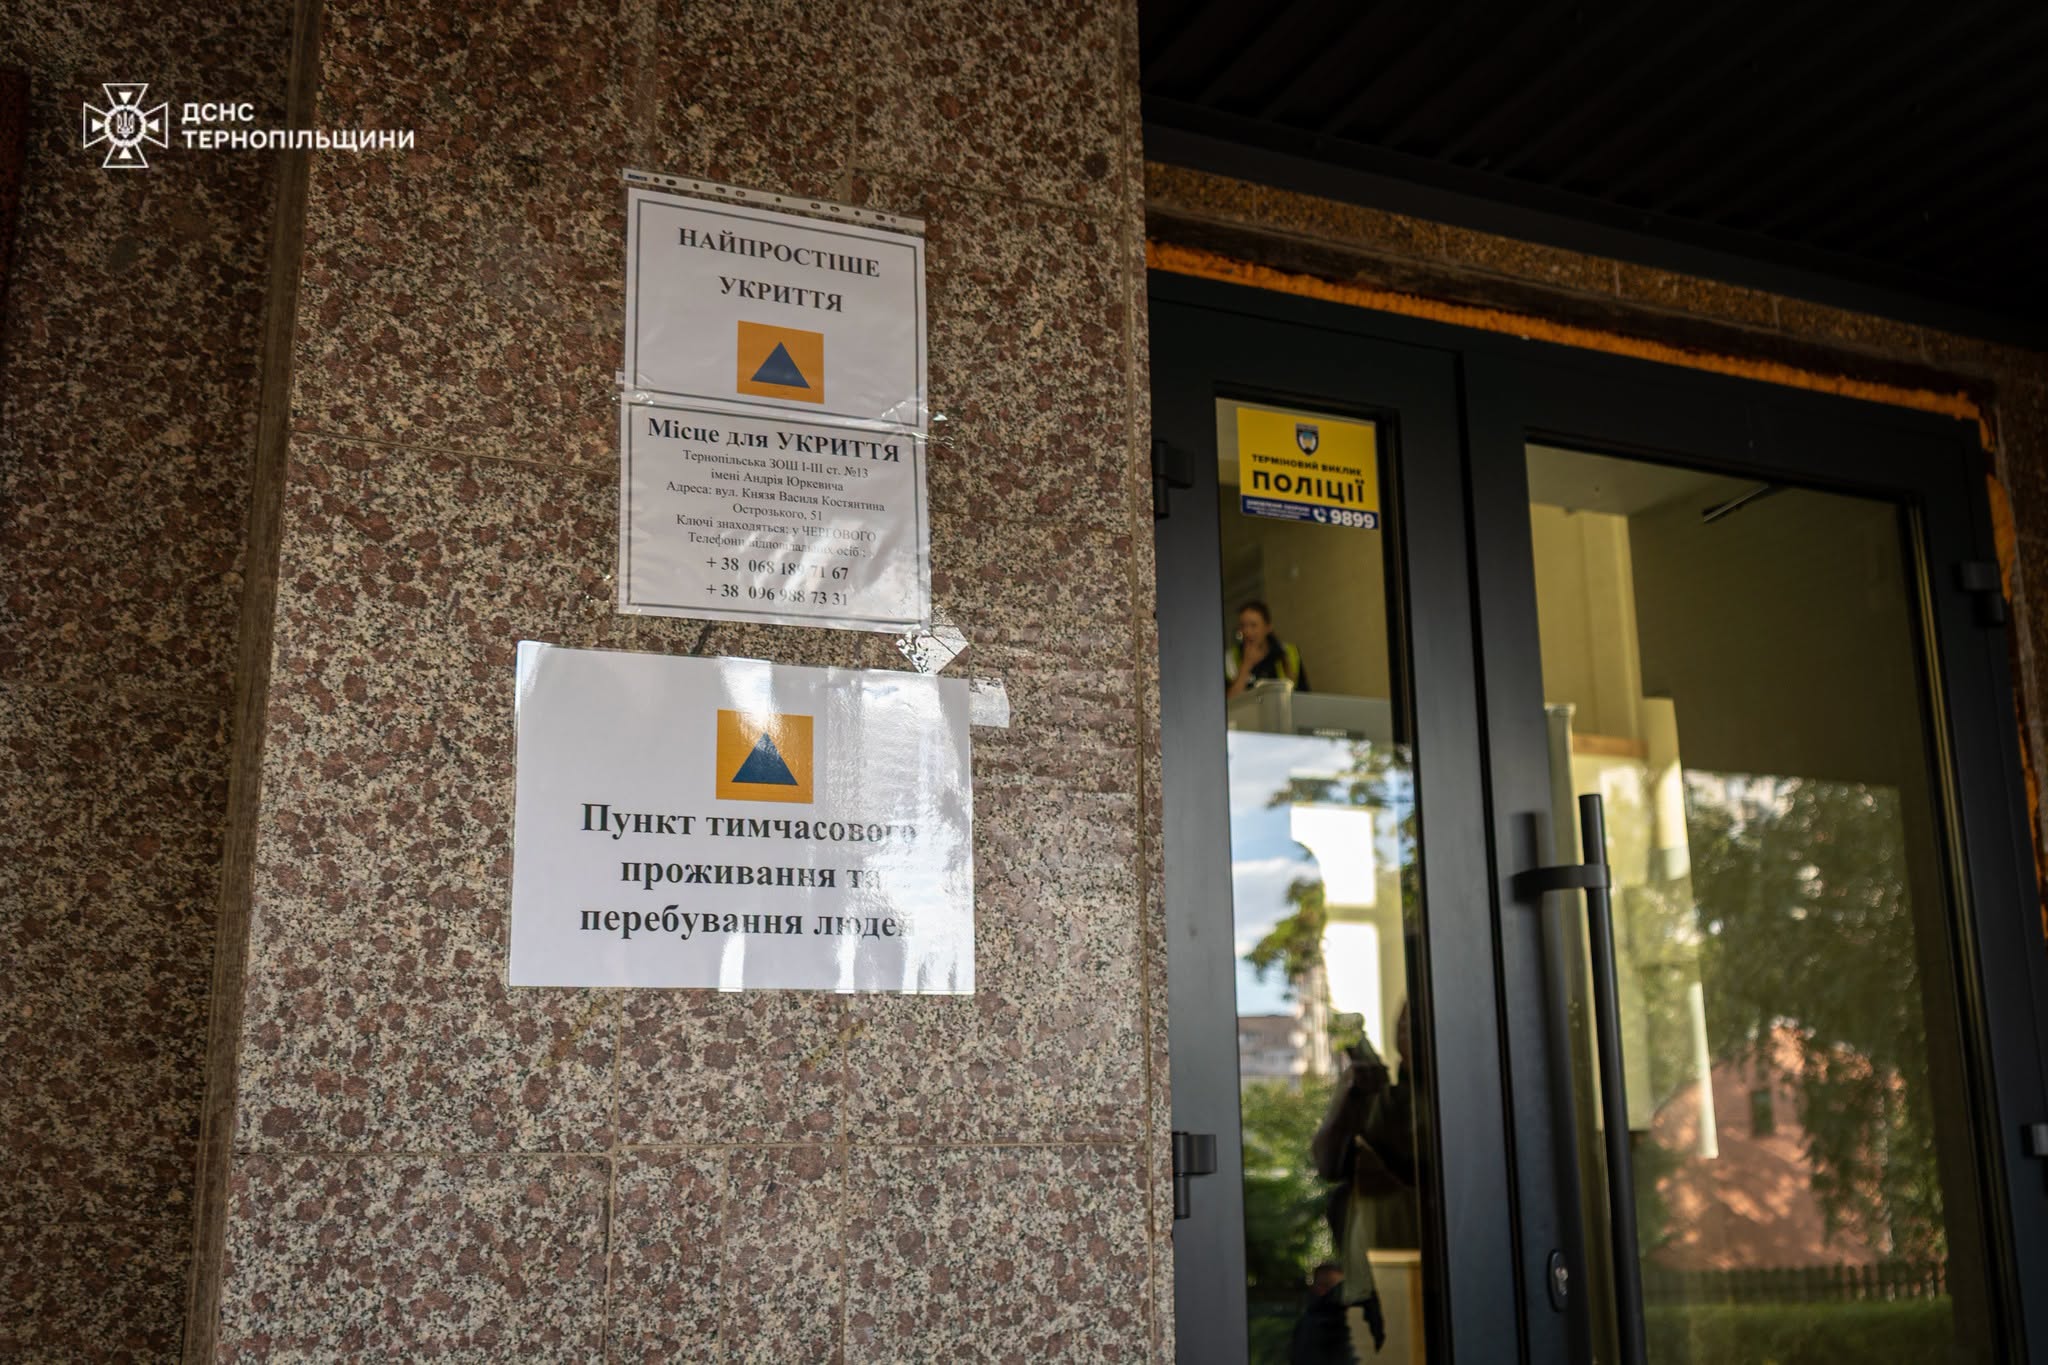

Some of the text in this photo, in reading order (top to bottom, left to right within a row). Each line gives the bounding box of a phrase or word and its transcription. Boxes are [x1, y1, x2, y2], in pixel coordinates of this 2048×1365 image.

[678, 227, 881, 278] НАЙПРОСТІШЕ
[718, 275, 843, 312] УКРИТТЯ
[648, 417, 900, 463] Місце для УКРИТТЯ
[683, 450, 767, 469] Тернопільська
[769, 458, 799, 472] ЗОШ
[826, 466, 841, 476] ст.
[843, 466, 869, 479] №13
[1252, 454, 1362, 476] ТЕРМІНОВИЙ ВИКЛИК
[711, 469, 844, 492] імені Андрія Юркевича
[1252, 470, 1365, 503] ПОЛІЦІЇ
[666, 481, 886, 512] Адреса: вул. Князя Василя Костянтина
[676, 514, 713, 528] Ключі
[716, 520, 789, 535] знаходяться:
[792, 527, 800, 537] у
[810, 510, 822, 521] 51
[1329, 509, 1375, 529] 9899
[721, 557, 739, 571] 38
[748, 560, 775, 575] 068
[831, 566, 849, 580] 67
[721, 584, 739, 598] 38
[748, 586, 775, 601] 096
[810, 591, 828, 605] 73
[831, 593, 848, 606] 31
[580, 803, 696, 840] Пункт
[620, 859, 836, 890] проживання
[580, 904, 804, 940] перебування
